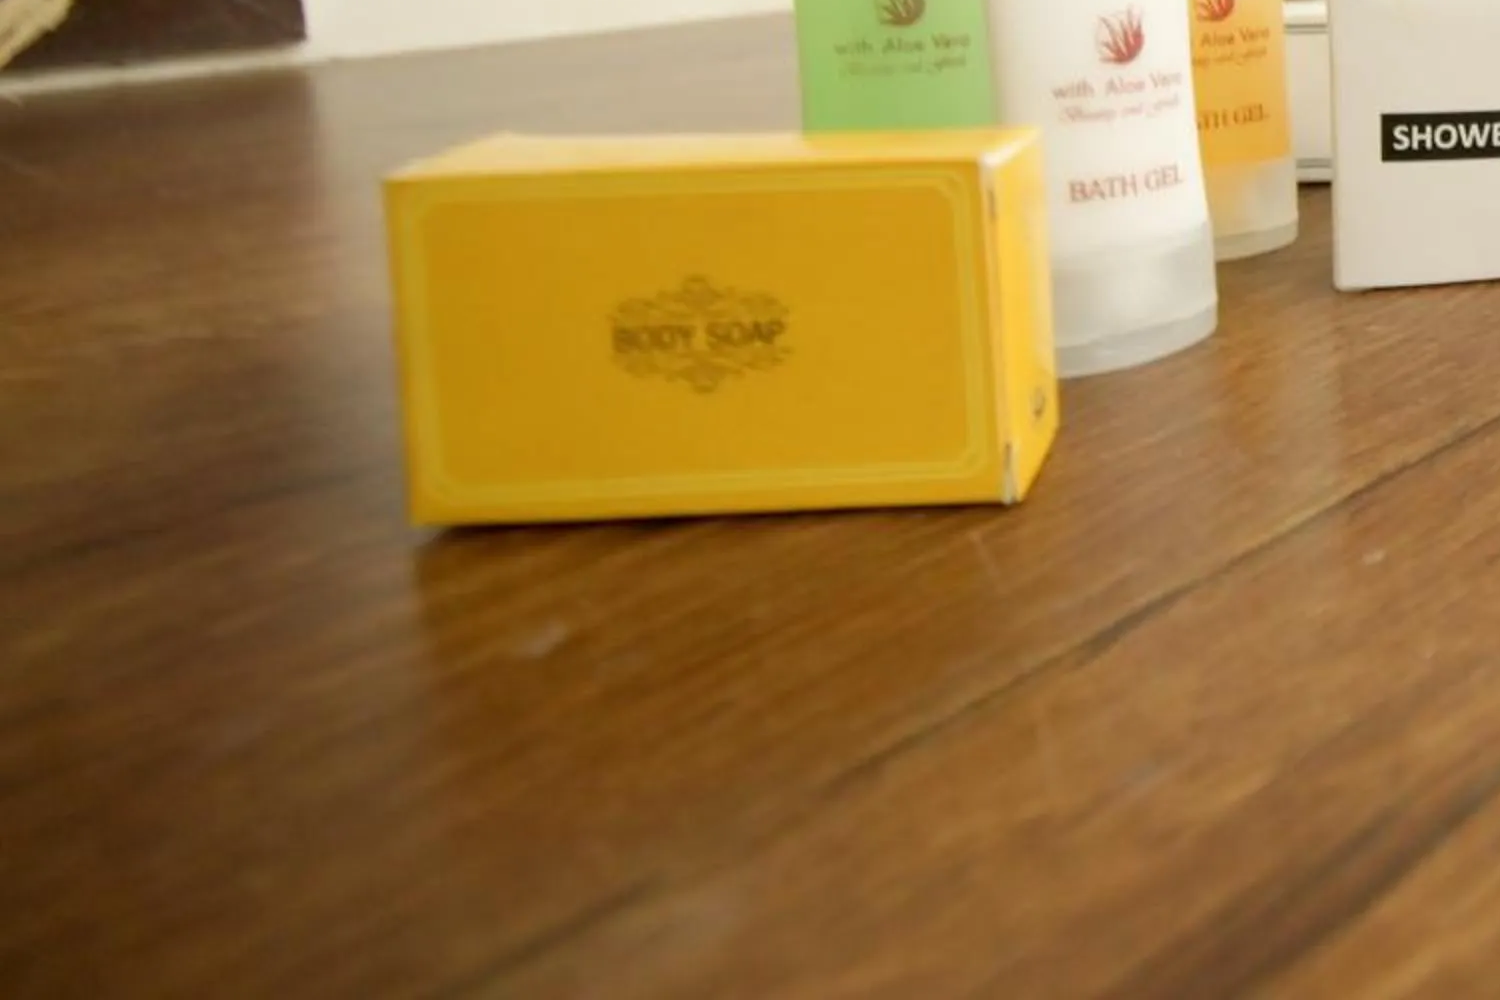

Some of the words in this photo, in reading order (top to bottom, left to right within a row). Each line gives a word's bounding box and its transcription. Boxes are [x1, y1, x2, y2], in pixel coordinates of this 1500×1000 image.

[1051, 75, 1095, 100] with
[1105, 75, 1146, 98] Aloe
[1148, 71, 1182, 88] Vera
[1197, 108, 1229, 131] TH
[1233, 102, 1270, 125] GEL
[1067, 173, 1138, 203] BATH
[1143, 163, 1184, 192] GEL
[612, 324, 697, 354] BODY
[705, 319, 787, 349] SOAP
